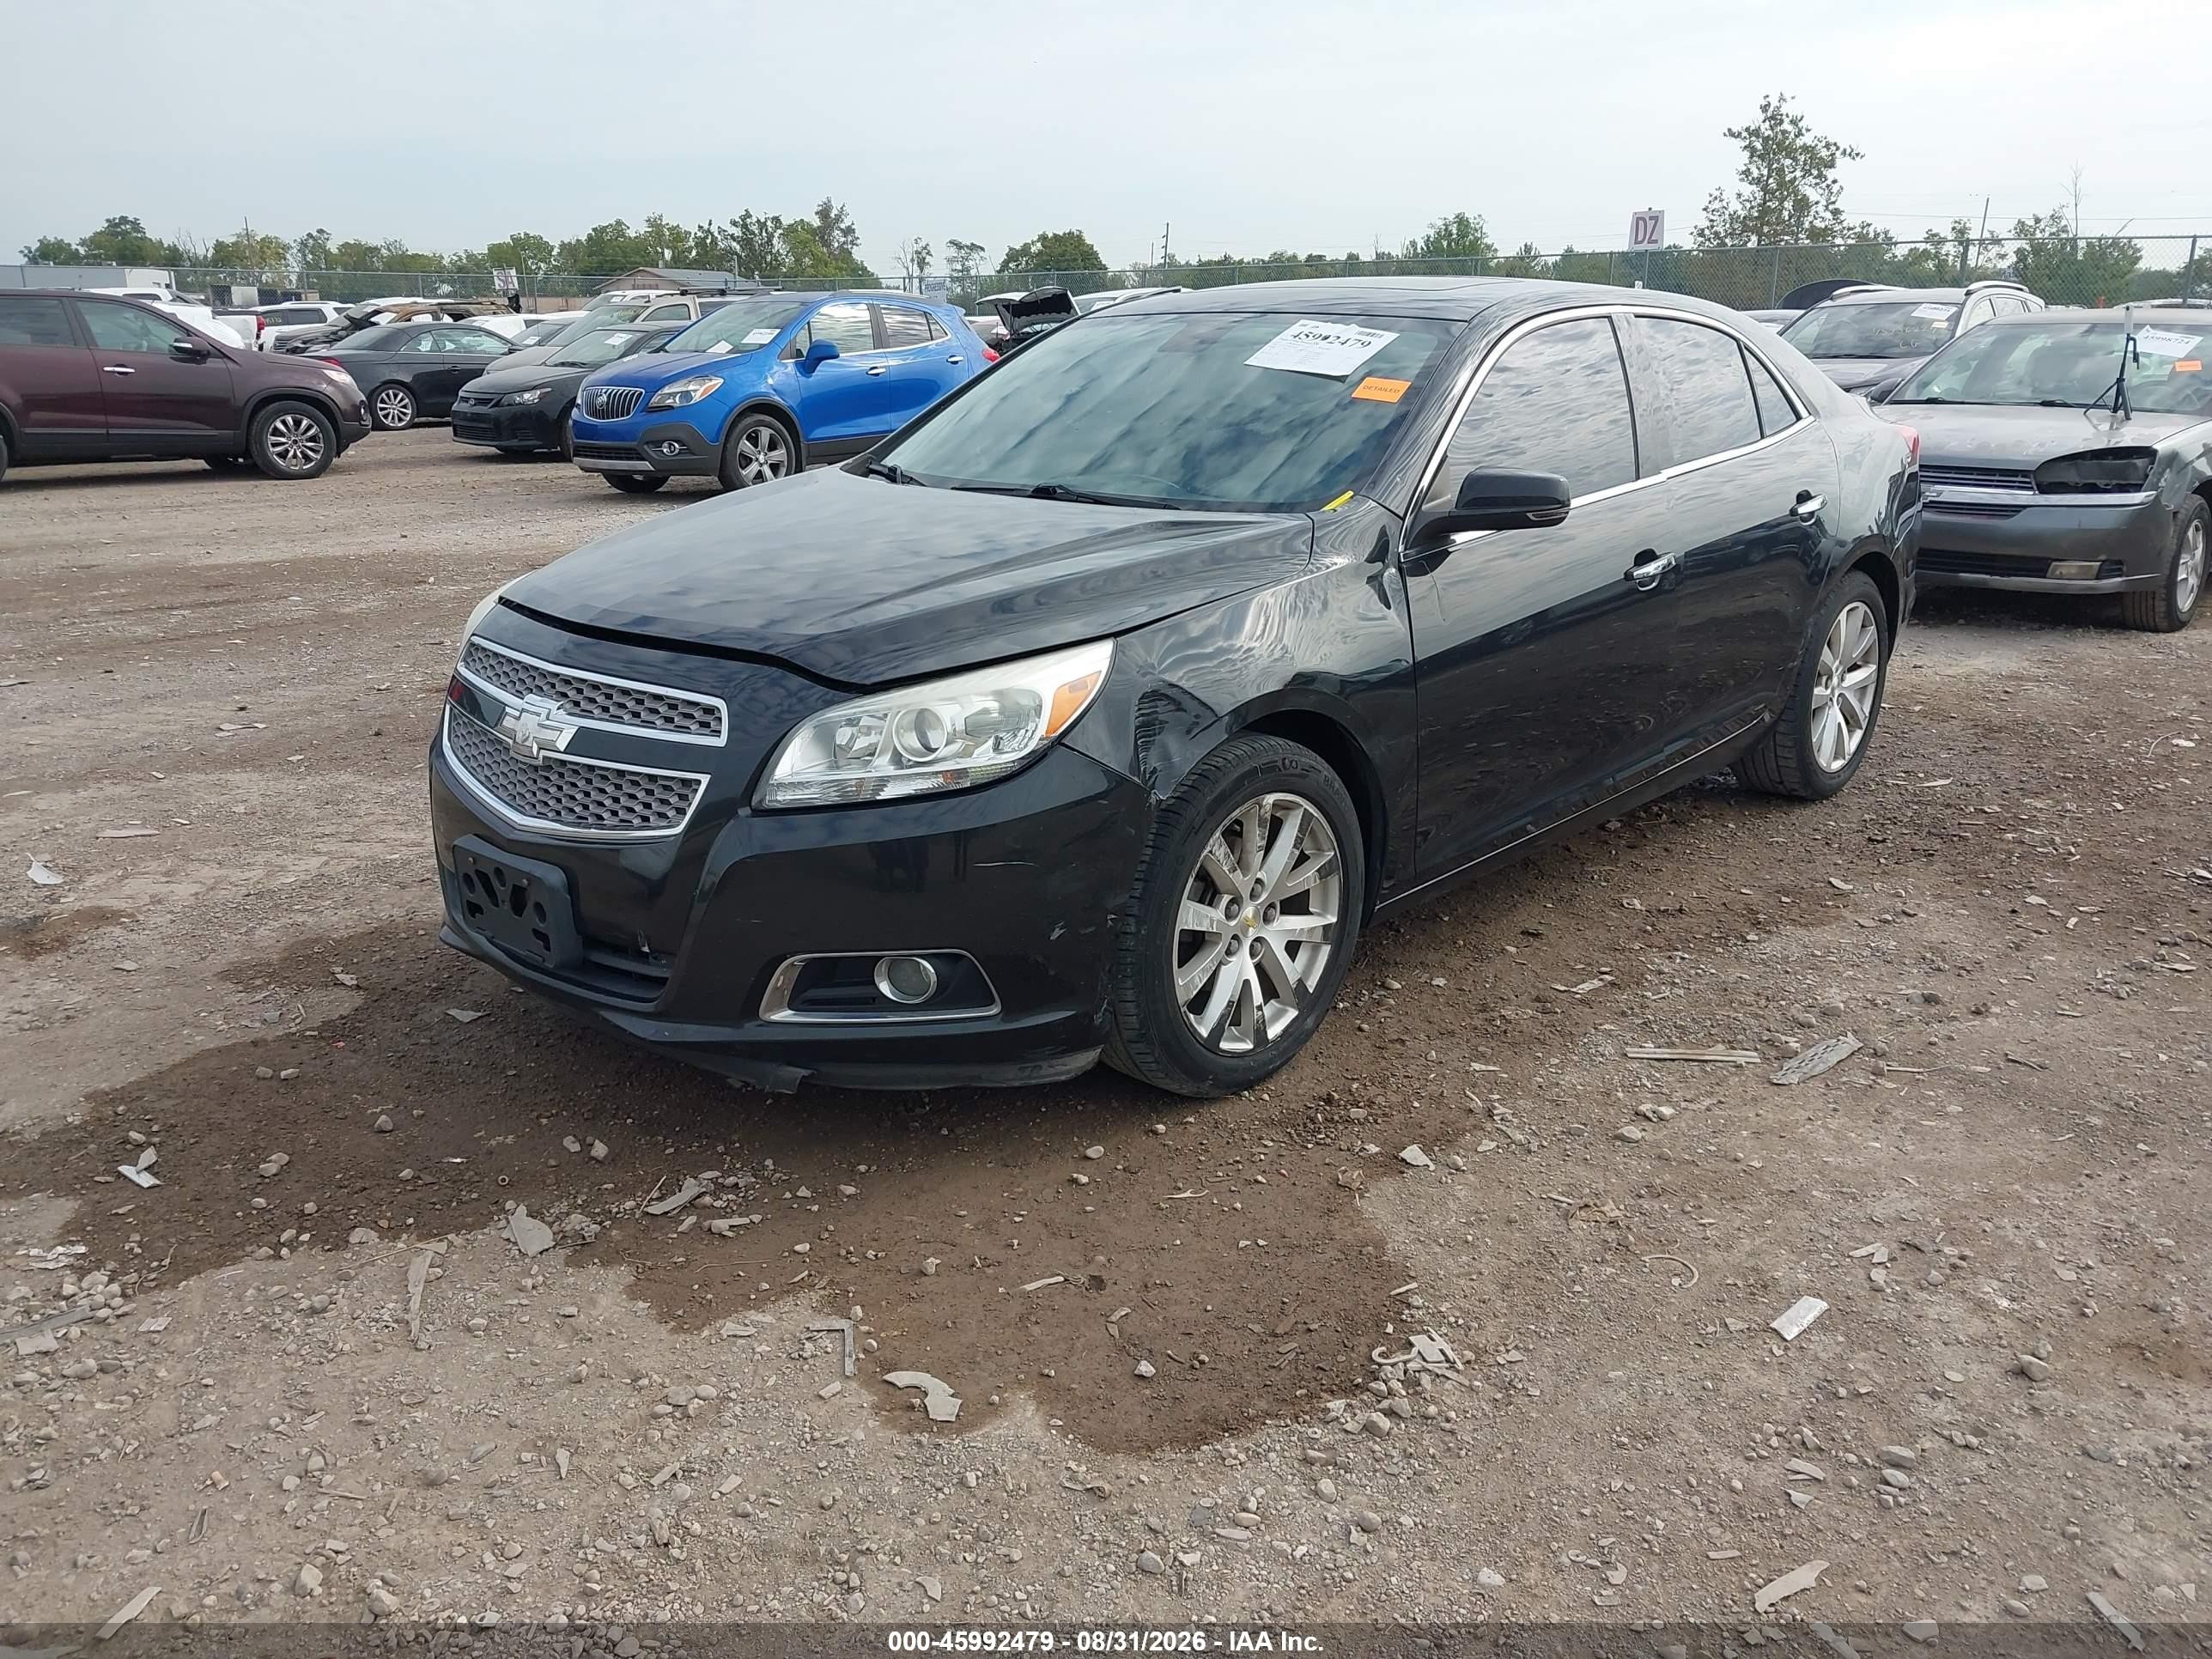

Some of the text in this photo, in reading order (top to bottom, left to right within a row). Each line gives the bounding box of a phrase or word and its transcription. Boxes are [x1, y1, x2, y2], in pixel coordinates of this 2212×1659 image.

[1634, 215, 1659, 245] DZ
[496, 270, 515, 289] SA
[1362, 385, 1401, 393] DETAILED
